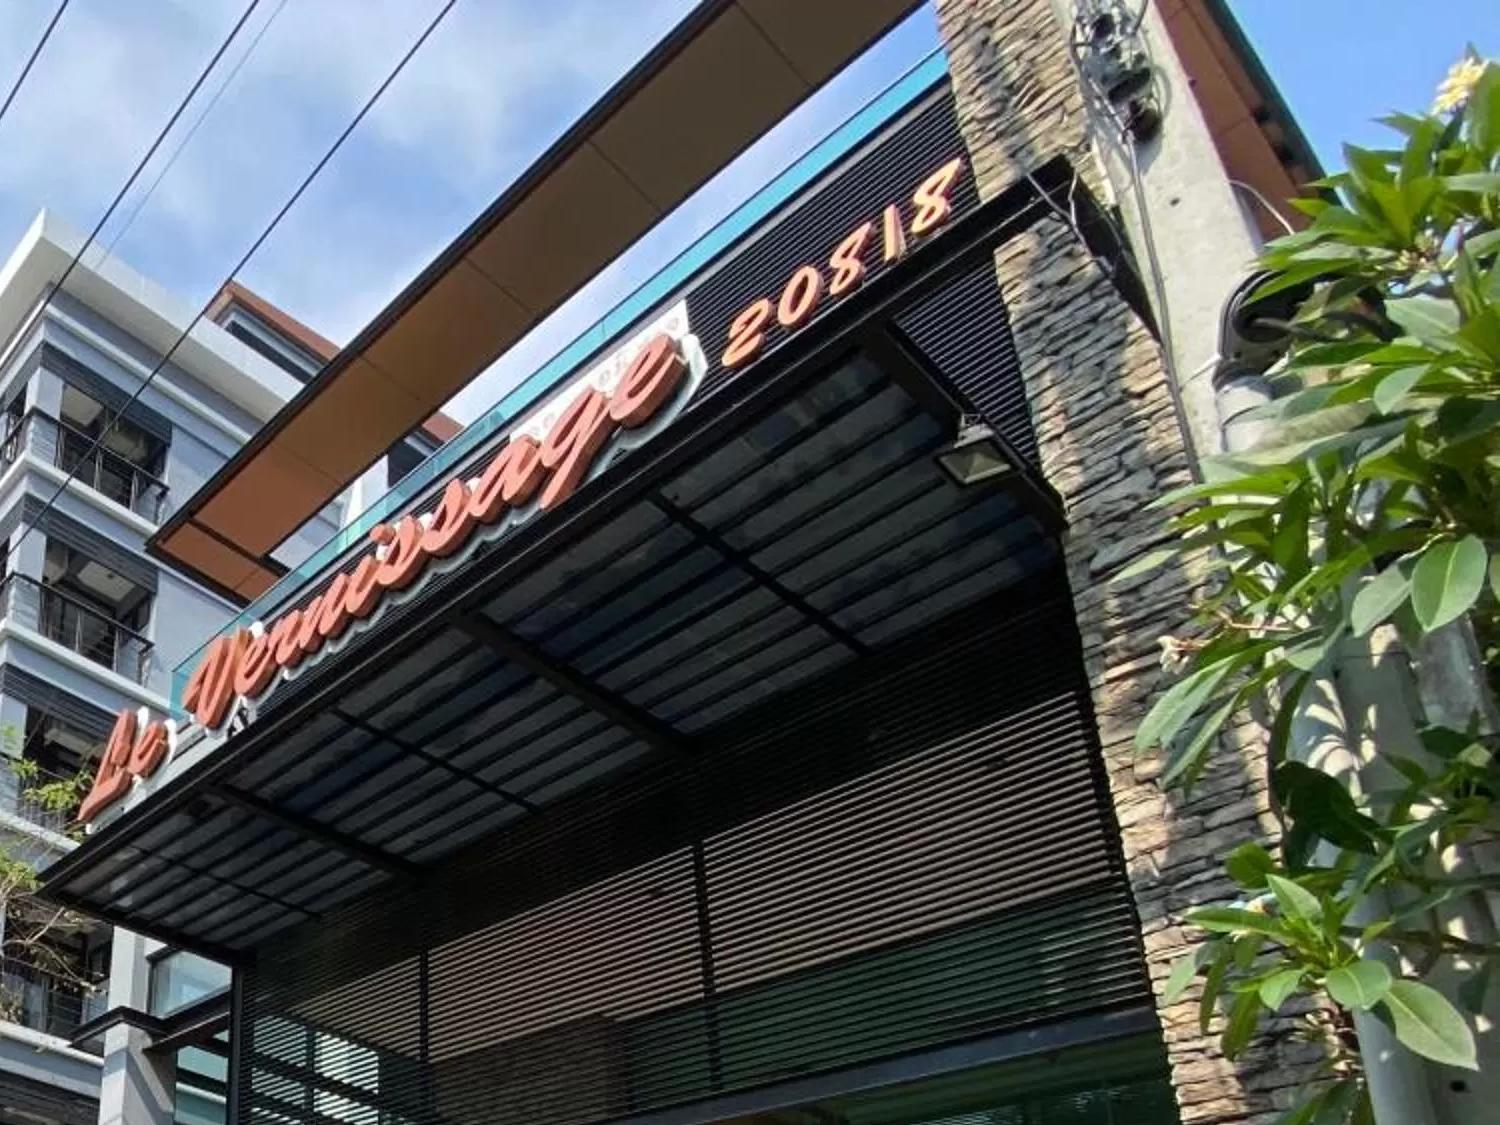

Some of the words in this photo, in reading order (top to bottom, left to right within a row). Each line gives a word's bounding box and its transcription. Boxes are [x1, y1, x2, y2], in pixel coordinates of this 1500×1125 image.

[77, 708, 168, 823] Le
[181, 328, 688, 730] Vernissage
[721, 156, 964, 367] 20818
